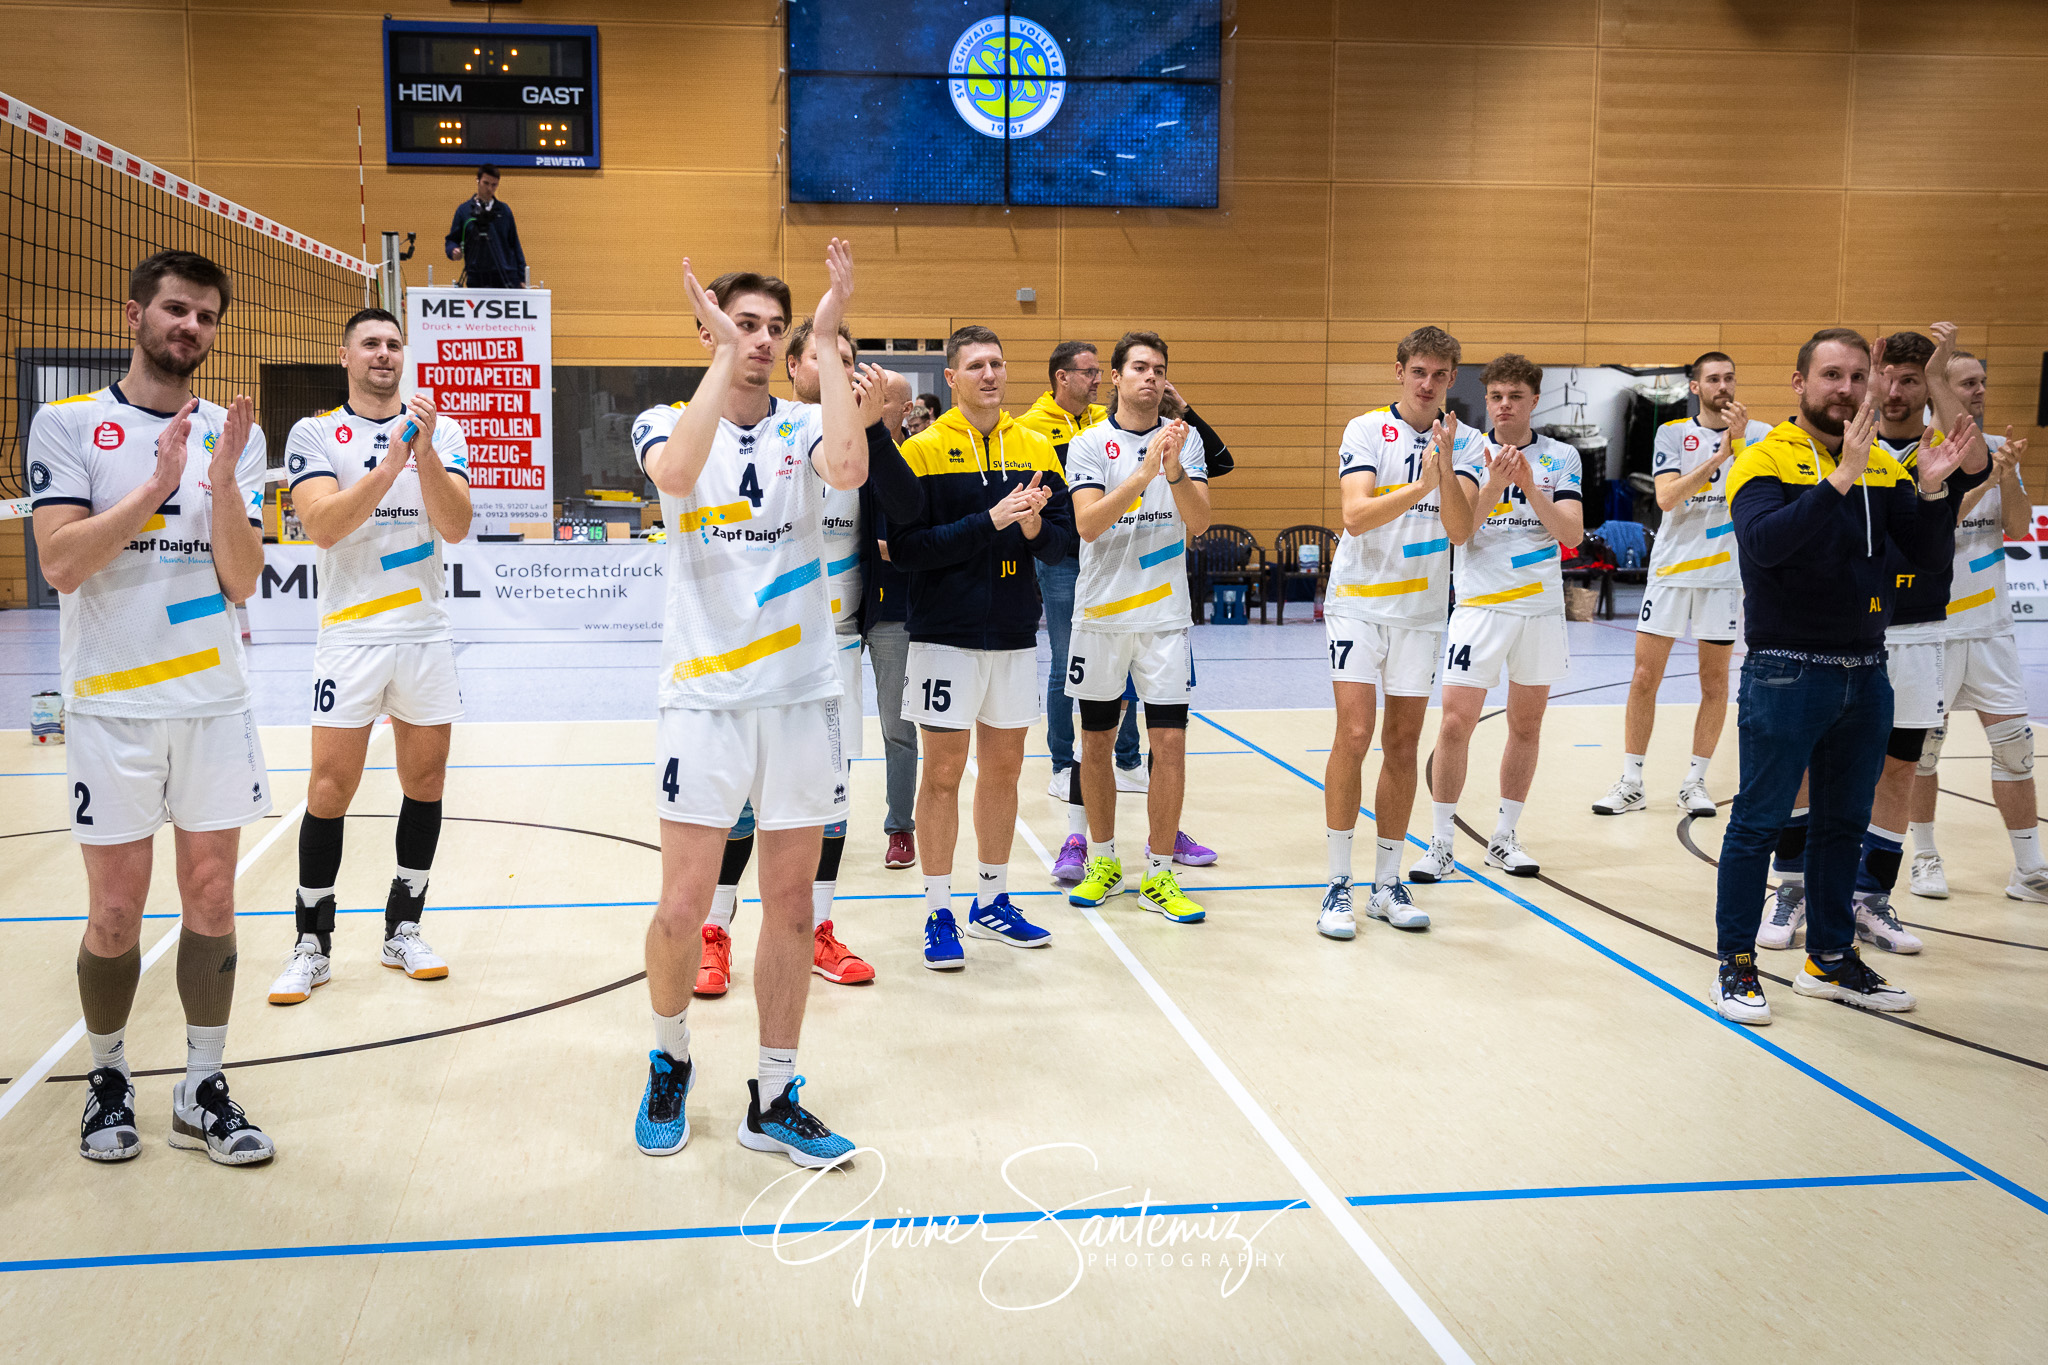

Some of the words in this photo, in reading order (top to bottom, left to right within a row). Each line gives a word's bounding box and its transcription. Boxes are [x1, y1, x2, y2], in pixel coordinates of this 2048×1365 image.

[954, 23, 993, 72] SCHWAIG
[1019, 23, 1060, 100] VOLLEYBALL
[398, 84, 462, 102] HEIM
[522, 86, 584, 105] GAST
[954, 83, 965, 99] SV
[991, 123, 1024, 135] 1967
[536, 156, 585, 167] PEWETA
[422, 299, 537, 319] MEYSEL
[422, 322, 452, 331] Druck
[465, 323, 536, 332] Werbetechnik
[442, 340, 517, 361] SCHILDER
[425, 366, 532, 387] FOTOTAPETEN
[441, 392, 523, 412] SCHRIFTEN
[457, 418, 533, 437] BEFOLIEN
[739, 463, 764, 507] 4
[375, 507, 419, 518] Daigfuss
[1118, 515, 1137, 525] Zap
[822, 516, 854, 529] igfuss
[1486, 518, 1507, 527] Zapf
[1508, 518, 1544, 527] Daigfus
[558, 526, 573, 540] 10
[589, 526, 603, 540] 15
[712, 525, 742, 542] Zapf
[123, 538, 156, 553] apf
[159, 539, 212, 554] Daigfu
[495, 563, 664, 578] Großformatdruck
[1001, 560, 1017, 577] JU
[1896, 574, 1916, 588] FT
[495, 585, 629, 599] Werbetechnik
[1641, 599, 1653, 622] 6
[1869, 597, 1882, 613] AL
[583, 621, 664, 632] www.meysel.de
[1329, 640, 1354, 670] 17
[1448, 643, 1472, 671] 14
[1068, 655, 1086, 685] 5
[313, 678, 337, 712] 16
[922, 679, 951, 712] 15
[662, 757, 680, 803] 4
[74, 781, 94, 826] 2
